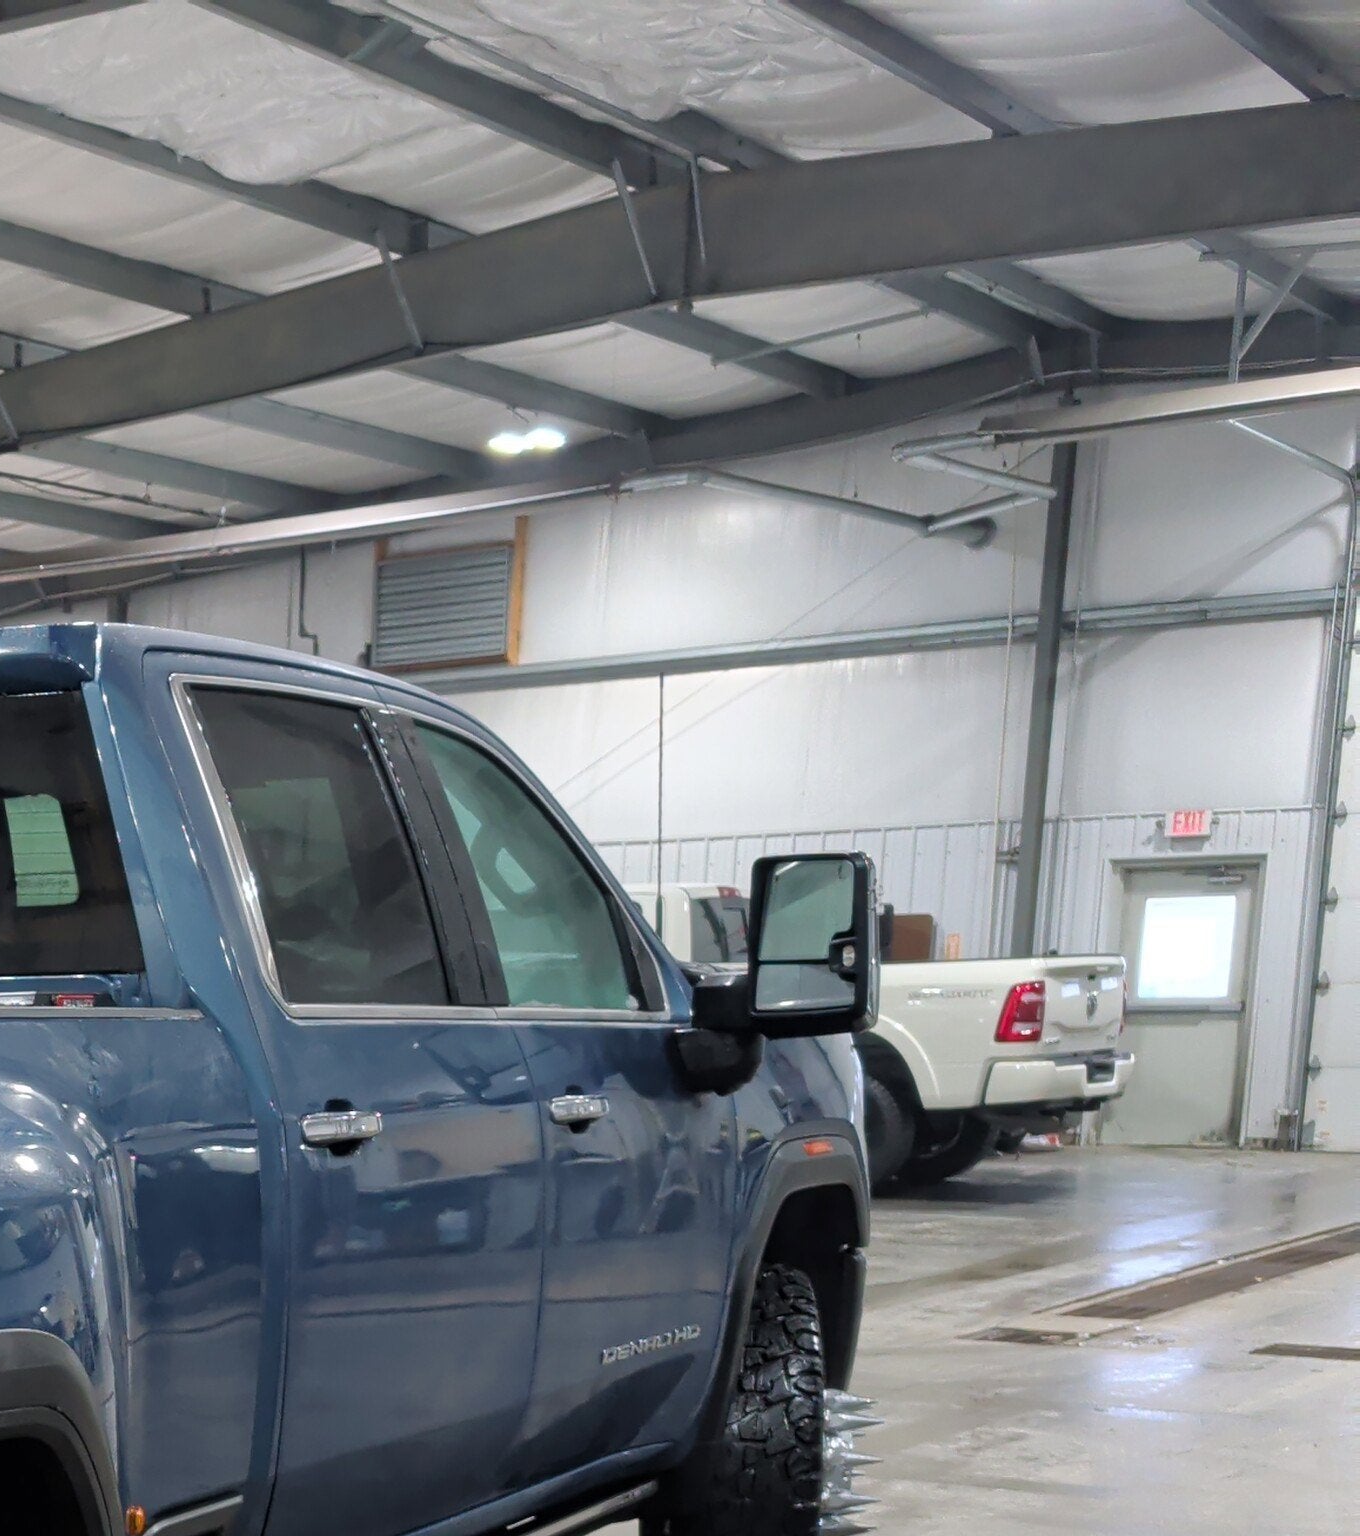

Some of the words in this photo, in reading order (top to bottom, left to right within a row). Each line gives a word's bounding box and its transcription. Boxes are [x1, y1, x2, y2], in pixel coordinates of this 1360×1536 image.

[1173, 810, 1205, 833] EXIT
[602, 1333, 672, 1365] DENALI
[674, 1324, 701, 1344] HD
